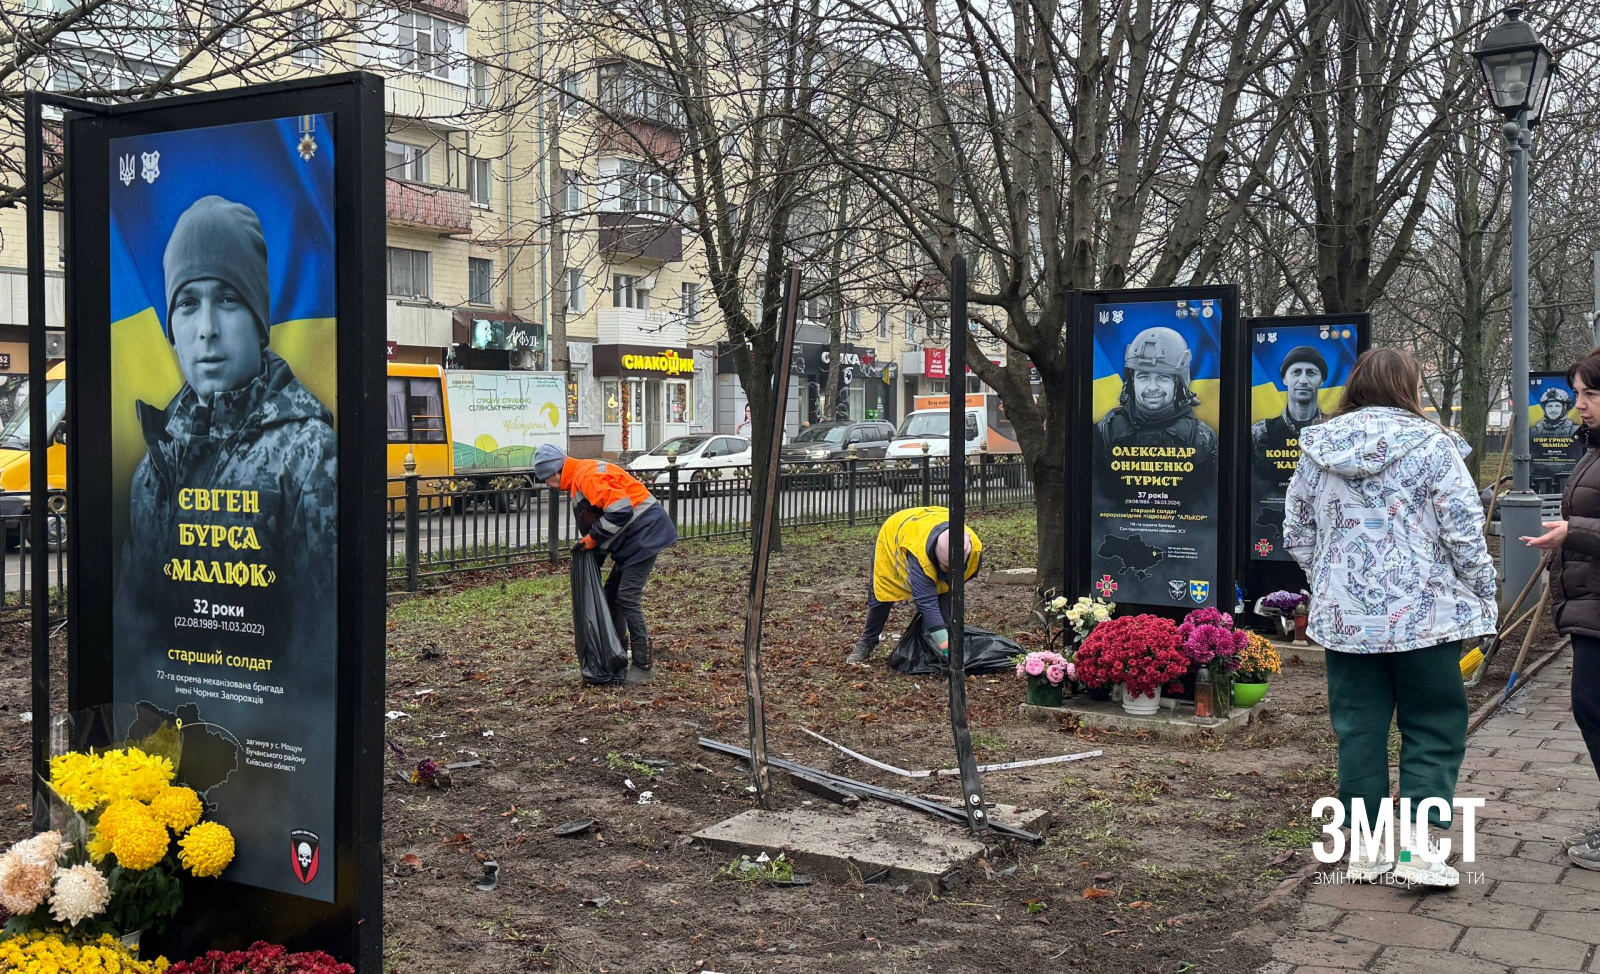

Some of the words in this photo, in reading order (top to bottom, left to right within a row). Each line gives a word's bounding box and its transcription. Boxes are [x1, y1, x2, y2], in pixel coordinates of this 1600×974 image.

[622, 354, 695, 374] СМАКОШИК
[1112, 445, 1196, 459] ОЛЕКСАНДР
[1110, 460, 1194, 473] ОНИЩЕНКО
[178, 488, 260, 513] ЄВГЕН
[1137, 491, 1147, 499] 37
[1148, 492, 1169, 501] років
[178, 523, 262, 550] БУРСА
[163, 558, 277, 587] «МАЛЮК»
[193, 599, 209, 614] 32
[211, 603, 245, 618] роки
[174, 616, 266, 636] (22.08.1989-11.03.2022)
[168, 648, 223, 665] старший
[226, 654, 273, 672] солдат
[156, 670, 175, 681] 72-га
[175, 673, 202, 684] окрема
[202, 678, 252, 690] механізована
[252, 682, 284, 694] бригада
[175, 685, 192, 695] імені
[193, 688, 220, 699] Чорних
[220, 691, 264, 705] Запорожців
[245, 747, 283, 760] Бучанського
[283, 754, 306, 765] району
[246, 738, 270, 749] загинув
[281, 742, 303, 754] Мощун
[245, 757, 273, 769] Київської
[273, 762, 296, 772] області
